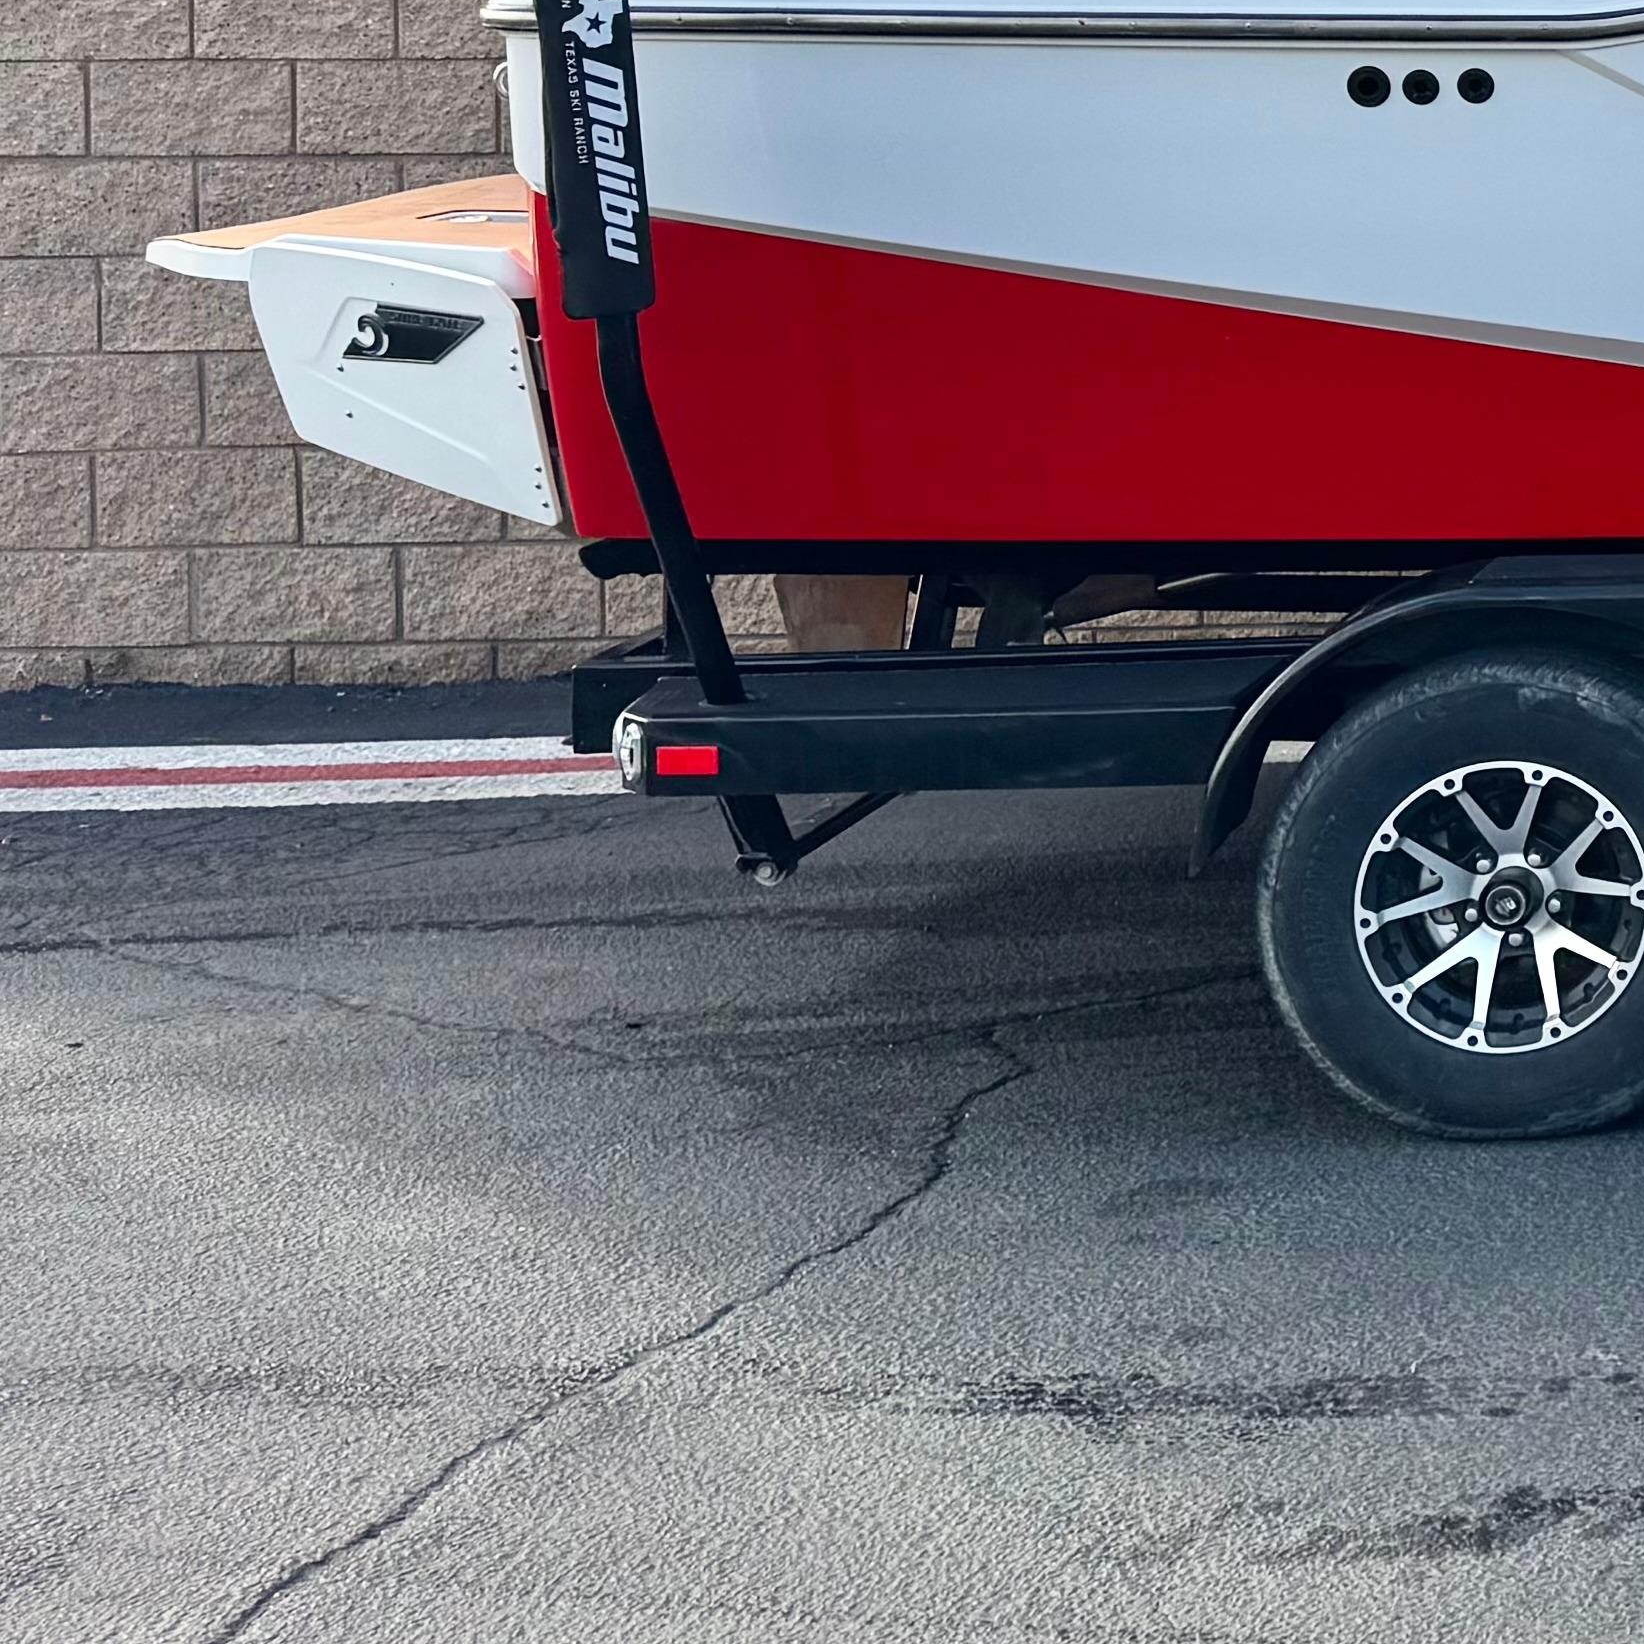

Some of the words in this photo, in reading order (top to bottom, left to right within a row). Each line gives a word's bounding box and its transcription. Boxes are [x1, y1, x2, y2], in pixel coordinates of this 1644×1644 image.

[564, 40, 579, 84] TEXAS
[569, 89, 582, 112] SKI
[573, 117, 590, 165] RANCH
